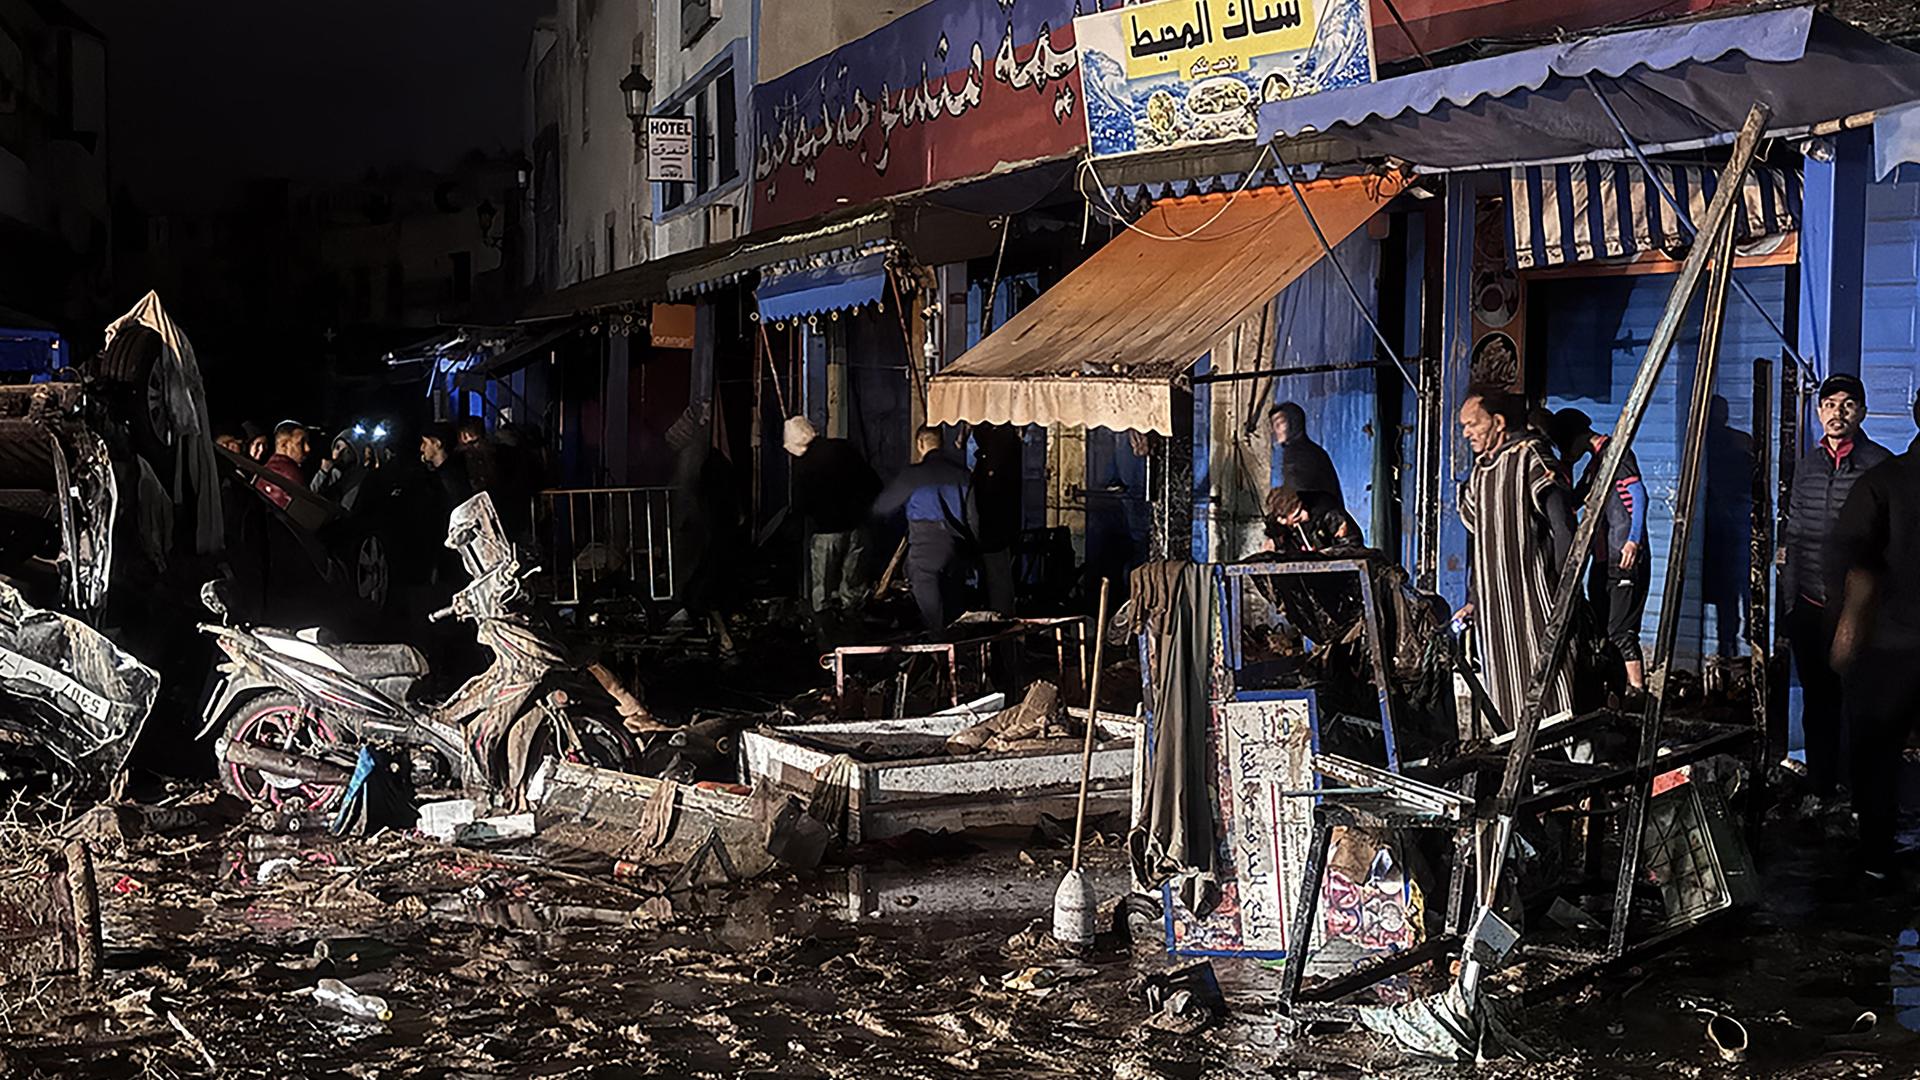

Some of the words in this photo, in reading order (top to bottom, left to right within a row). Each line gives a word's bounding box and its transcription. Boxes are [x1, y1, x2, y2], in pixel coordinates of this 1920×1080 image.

[1130, 0, 1213, 62] المحيط
[650, 122, 691, 136] HOTEL
[652, 143, 689, 156] فندق
